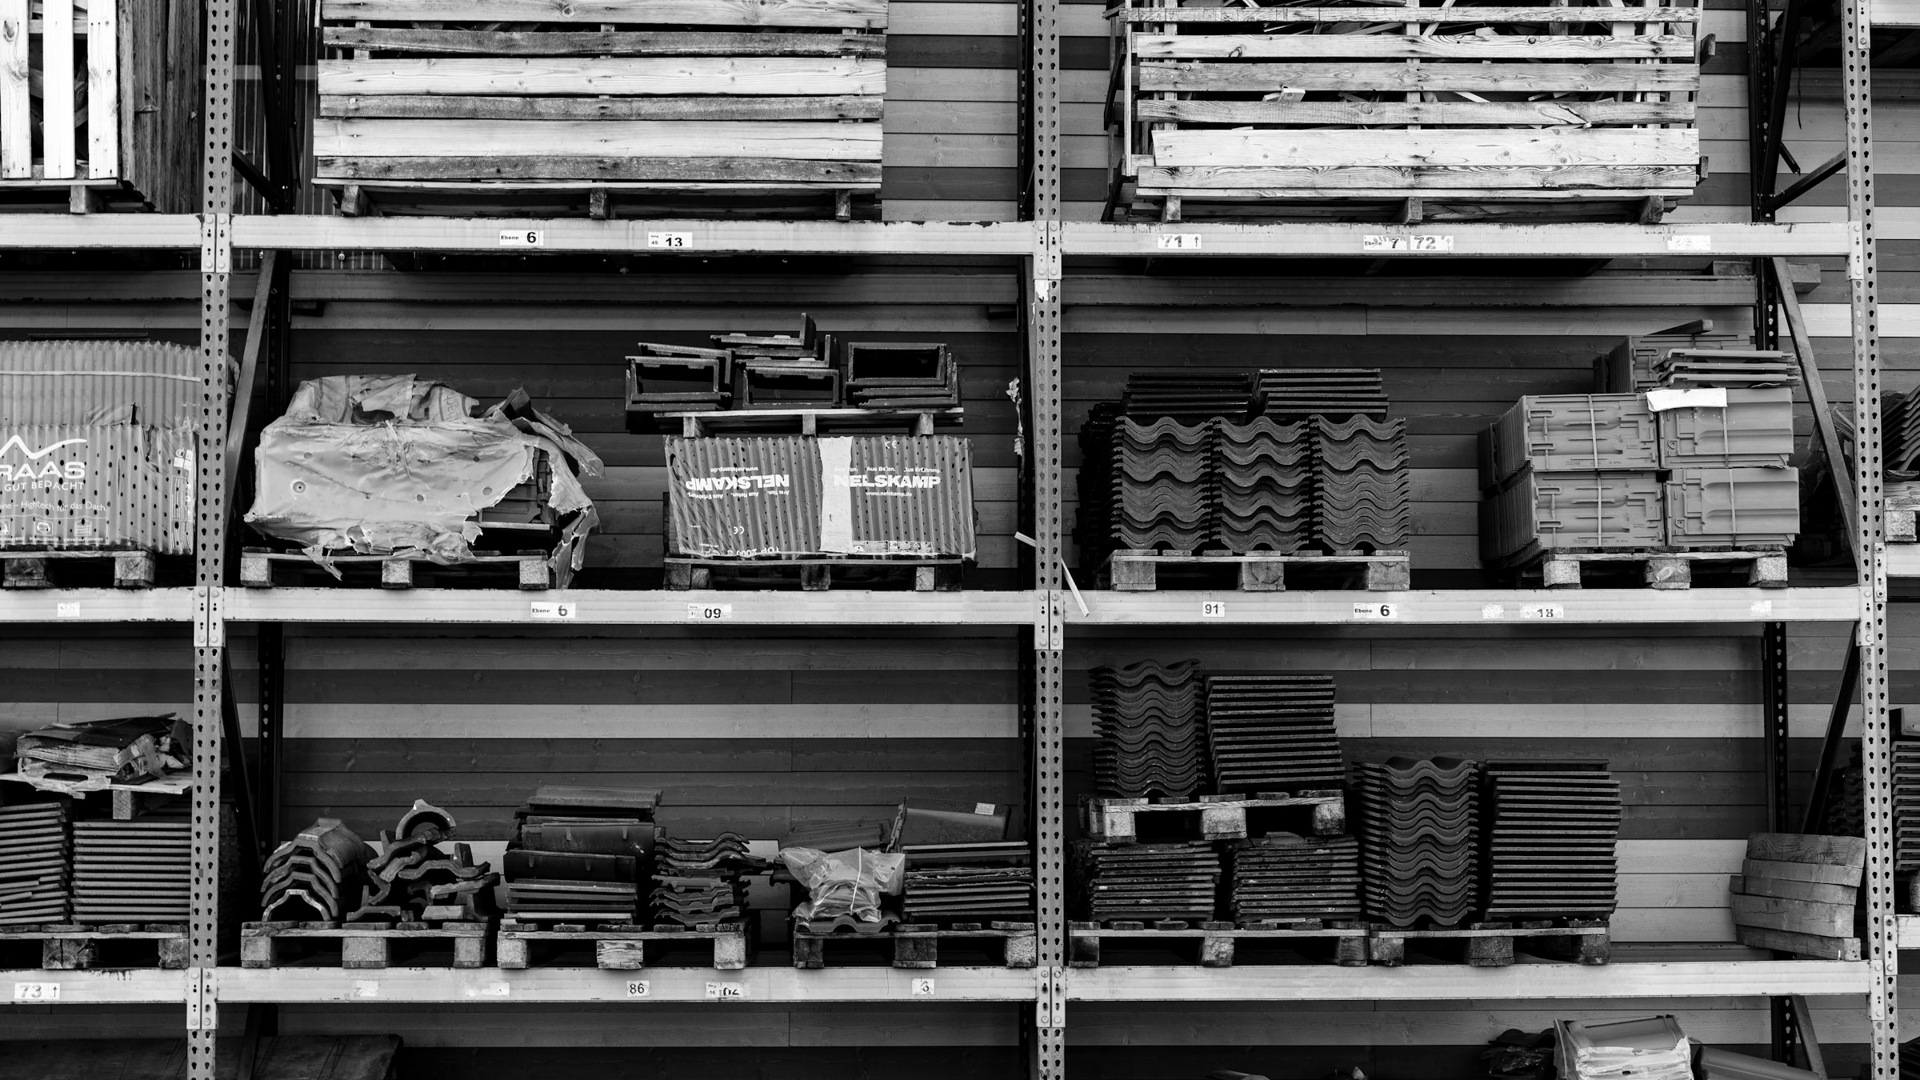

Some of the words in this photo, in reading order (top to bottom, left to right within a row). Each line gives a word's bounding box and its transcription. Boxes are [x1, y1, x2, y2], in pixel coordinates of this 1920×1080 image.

[526, 231, 537, 244] 6
[665, 237, 683, 247] 13
[1413, 236, 1437, 249] 72
[4, 483, 27, 492] GUT
[31, 480, 85, 491] BEDACHT
[685, 474, 790, 491] NELSKAMP
[833, 474, 942, 489] NELSKAMP
[21, 500, 55, 511] Hightech
[70, 502, 83, 510] das
[558, 605, 568, 617] 6
[704, 608, 722, 619] 09
[1205, 604, 1219, 615] 91
[1380, 605, 1391, 617] 6
[1537, 608, 1554, 618] 18
[19, 984, 43, 998] 73
[629, 983, 645, 994] 86
